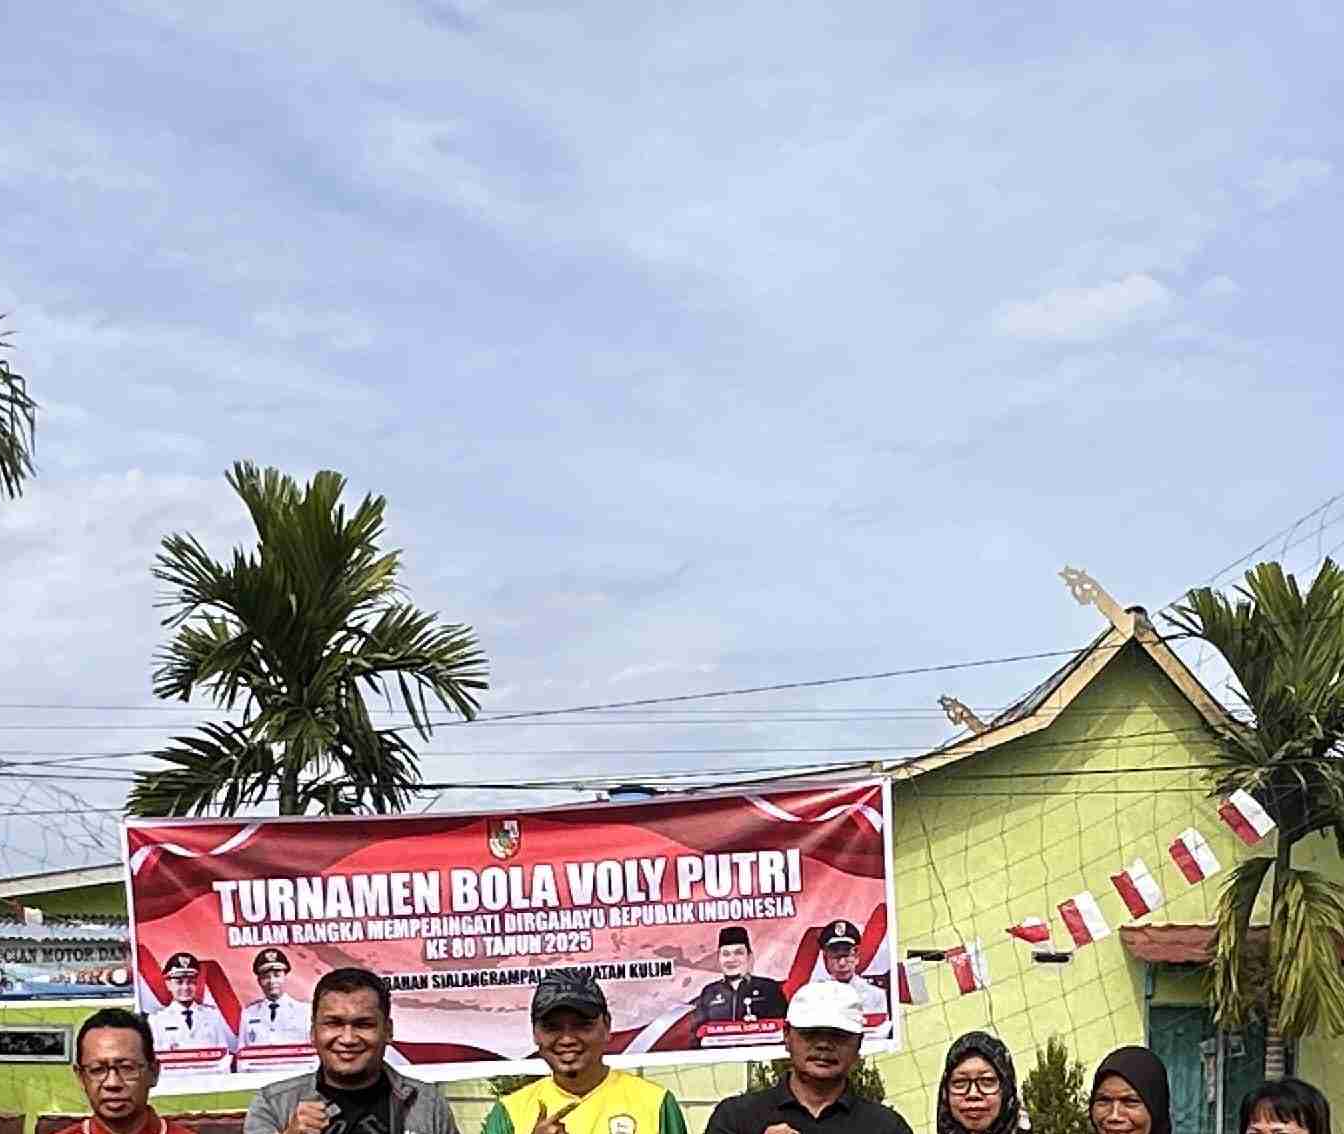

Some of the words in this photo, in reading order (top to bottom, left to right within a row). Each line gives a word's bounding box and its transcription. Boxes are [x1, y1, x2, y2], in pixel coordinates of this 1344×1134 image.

[213, 870, 441, 924] TURNAMEN
[451, 864, 559, 912] BOLA
[565, 856, 666, 905] VOLY
[677, 848, 802, 900] PUTRI
[229, 925, 289, 947] DALAM
[292, 921, 364, 943] RANGKA
[367, 914, 501, 940] MEMPERINGATI
[504, 907, 606, 933] DIRGAHAYU
[609, 901, 695, 928] REPUBLIK
[698, 896, 795, 922] INDONESIA
[426, 939, 448, 960] KE
[452, 938, 475, 959] 80
[485, 935, 542, 957] TAHUN
[544, 931, 592, 953] 2025
[629, 960, 672, 978] KULIM
